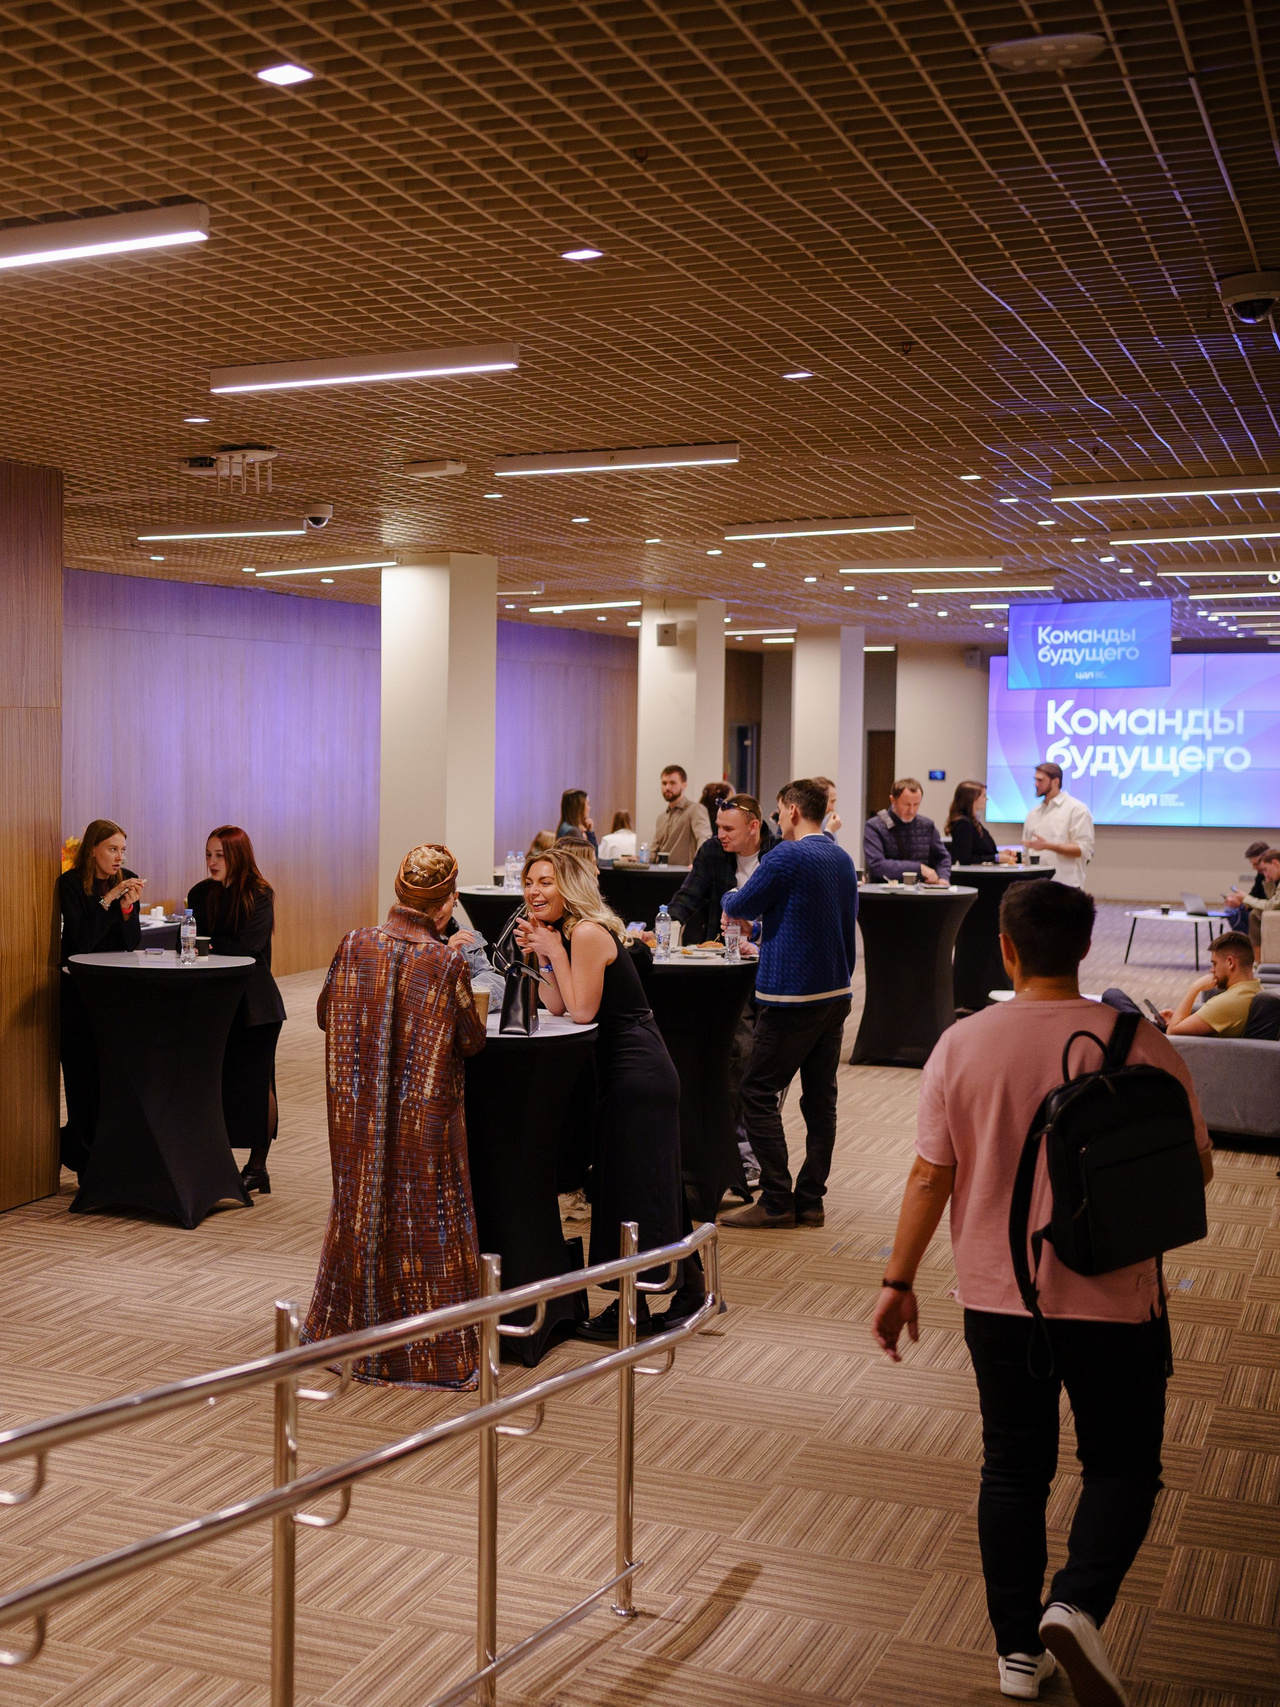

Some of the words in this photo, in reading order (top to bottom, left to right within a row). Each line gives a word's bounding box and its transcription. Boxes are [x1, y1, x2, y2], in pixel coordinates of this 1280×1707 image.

[1038, 626, 1136, 645] Команды
[1038, 645, 1139, 666] будущего
[1047, 700, 1244, 741] Команды
[1046, 736, 1251, 779] будущего
